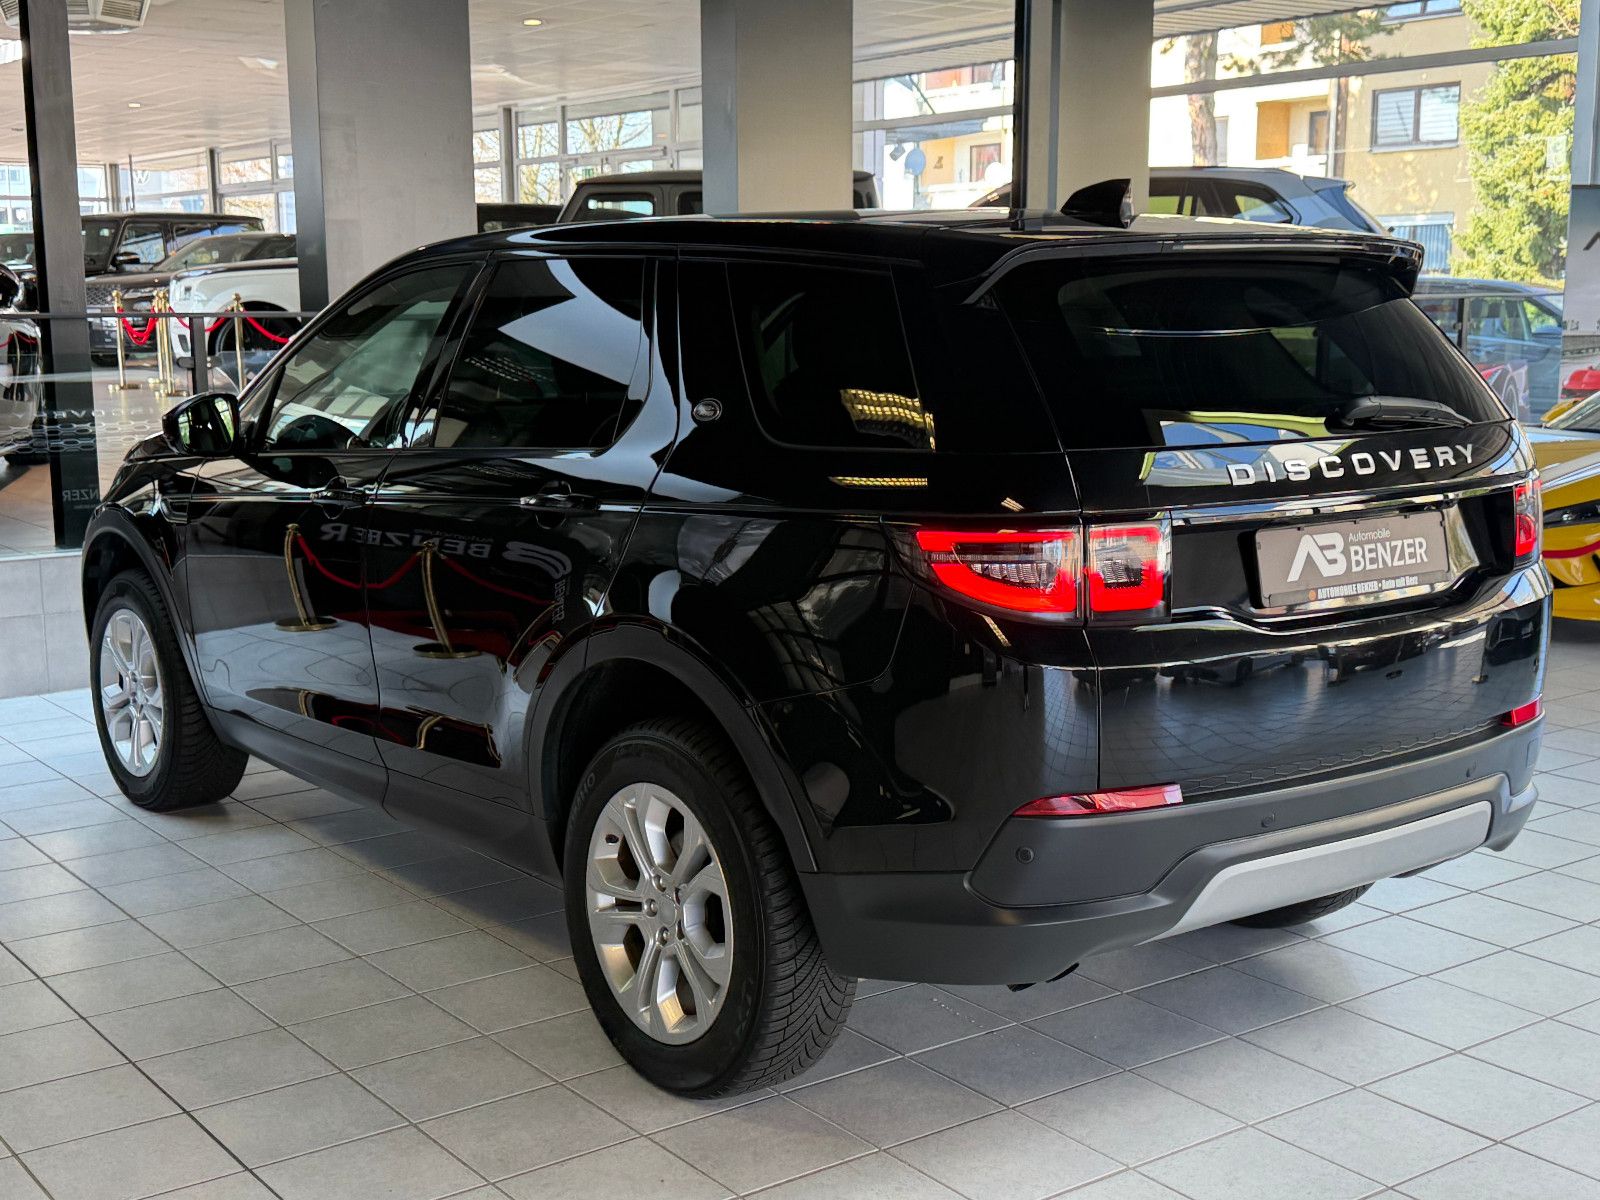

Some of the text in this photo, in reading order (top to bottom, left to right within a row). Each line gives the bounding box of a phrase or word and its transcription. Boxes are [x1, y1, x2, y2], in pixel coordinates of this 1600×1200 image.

[1226, 444, 1473, 487] DISCOVERY
[1348, 528, 1391, 543] Automobile
[1350, 536, 1428, 573] BENZER
[1317, 584, 1357, 600] AUTOMOBILE
[1356, 580, 1378, 594] BENZER
